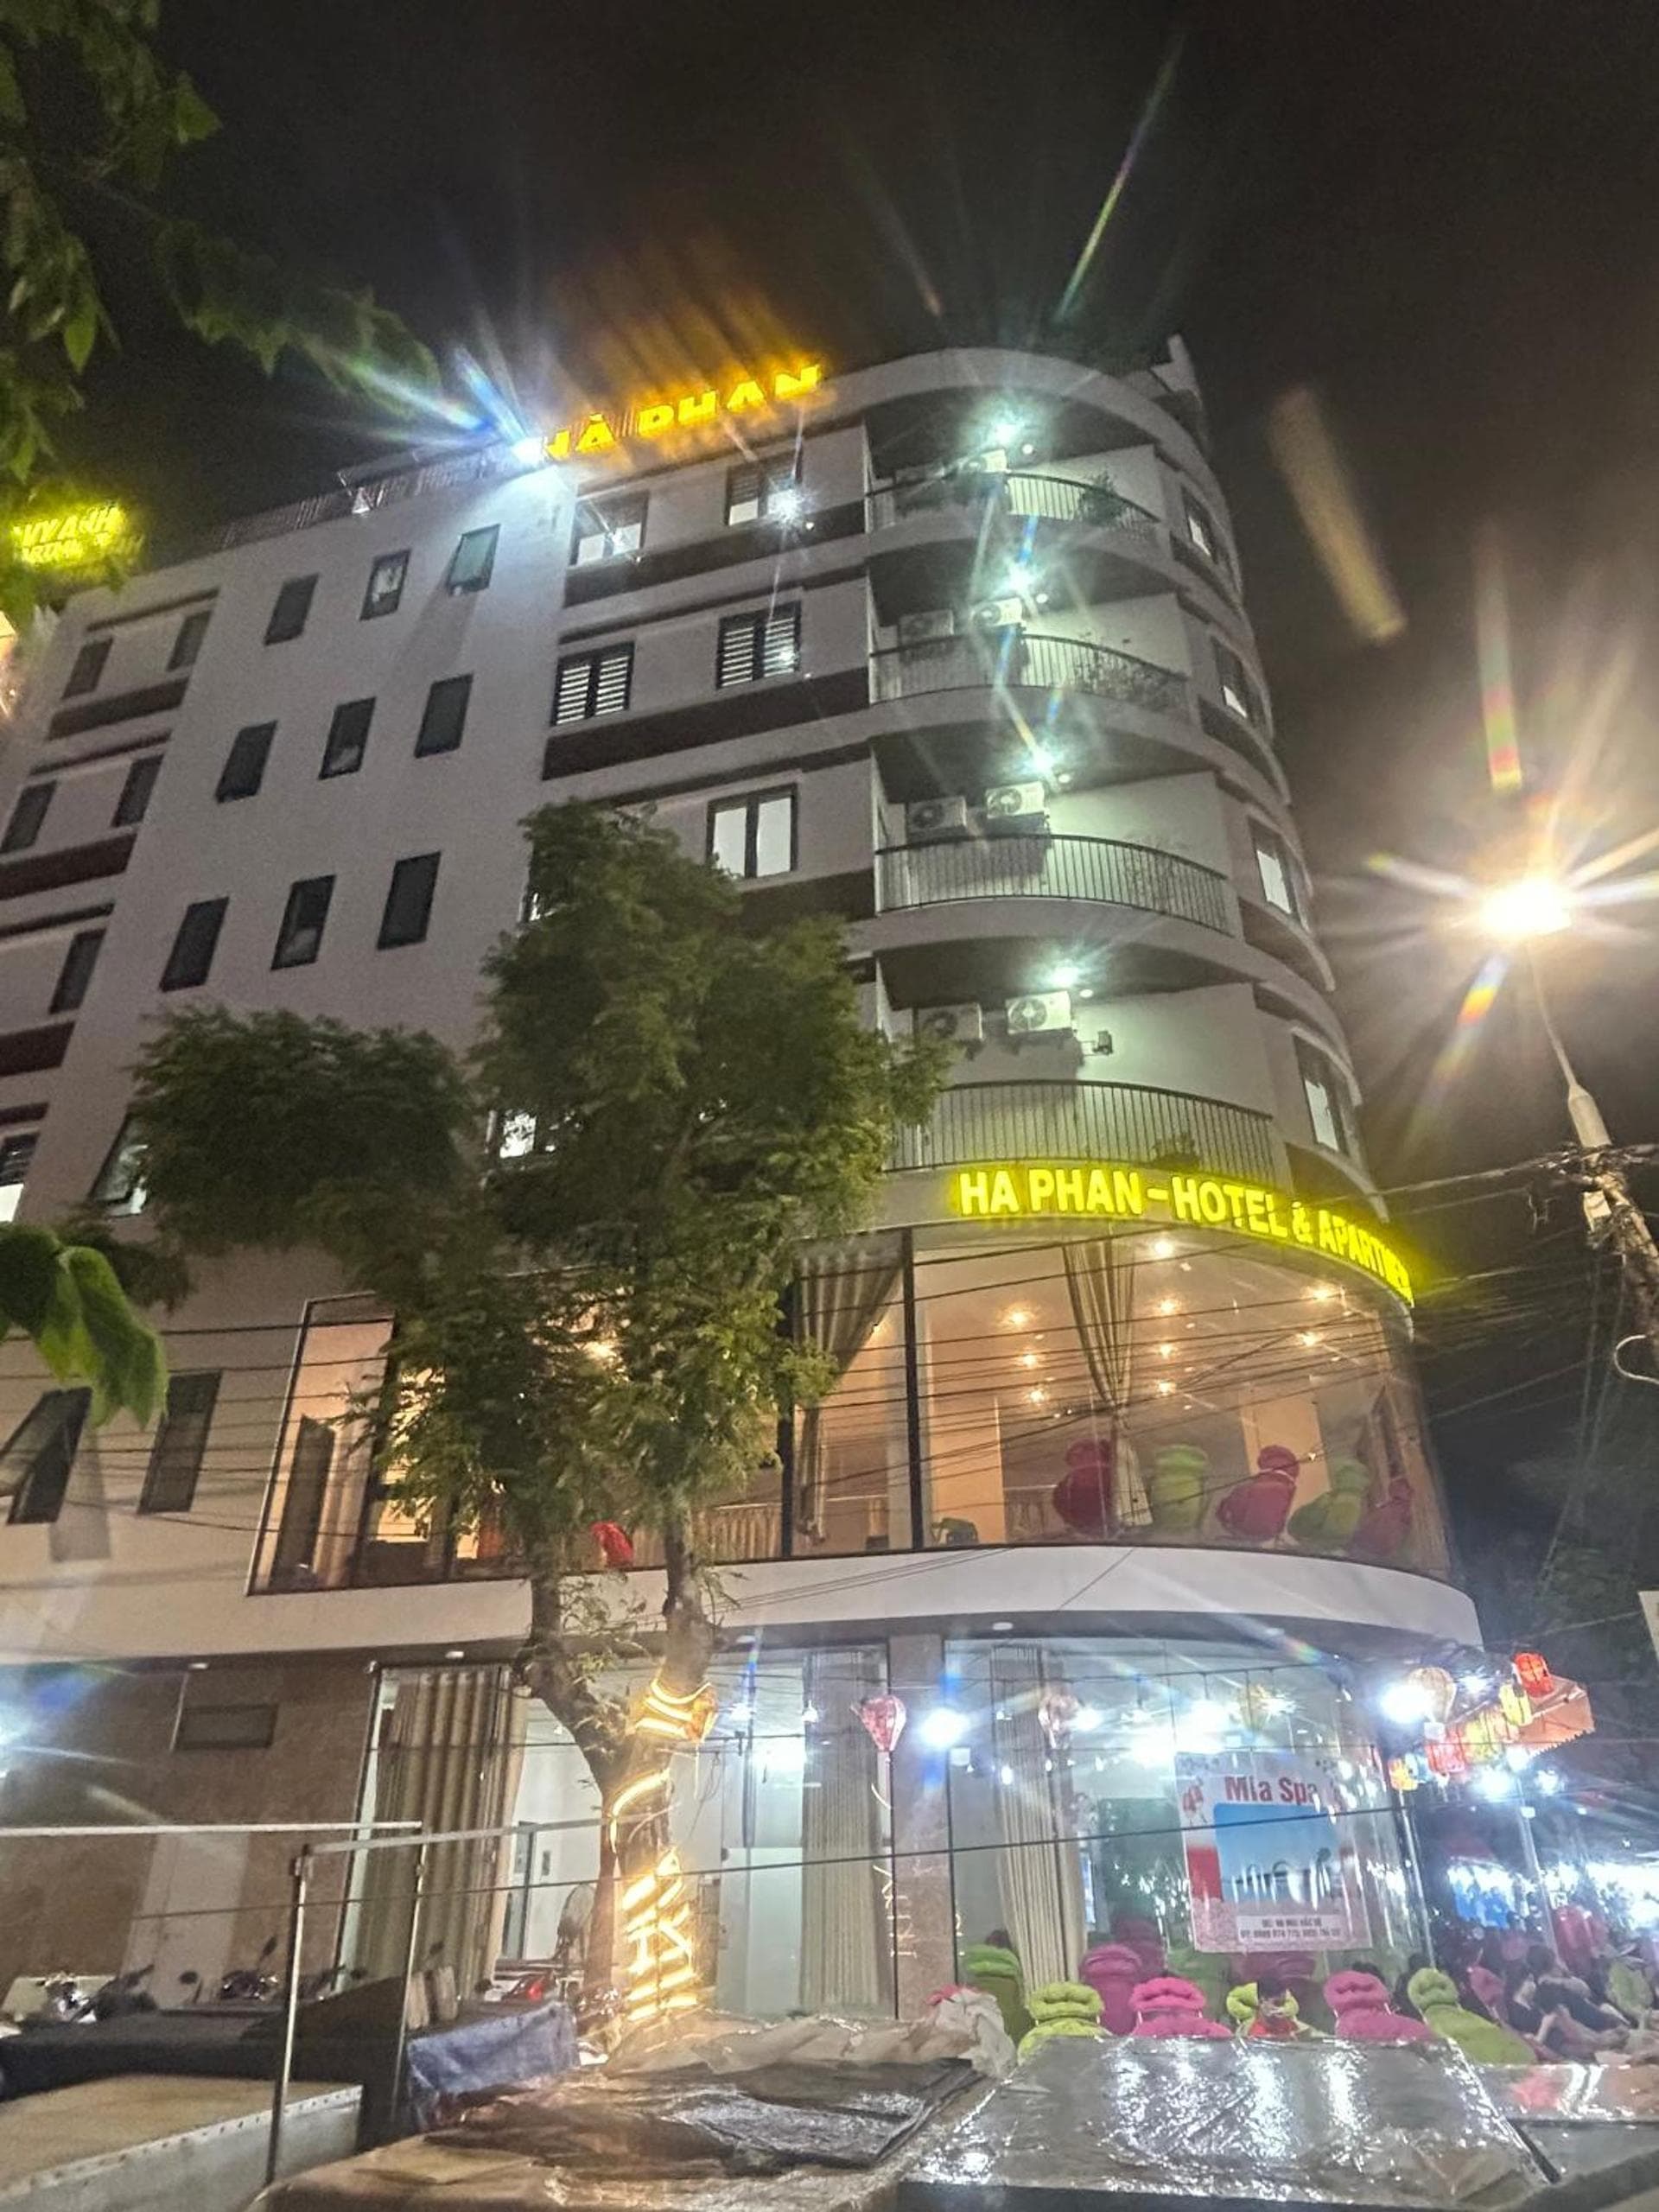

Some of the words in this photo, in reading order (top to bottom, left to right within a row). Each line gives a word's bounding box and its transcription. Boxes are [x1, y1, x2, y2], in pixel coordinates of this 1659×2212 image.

[638, 364, 823, 437] PHAN
[958, 1169, 1020, 1215] HA
[1028, 1168, 1143, 1215] PHAN
[1171, 1176, 1288, 1238] HOTEL
[1292, 1201, 1313, 1244] &
[1224, 1776, 1273, 1802] Mia
[1279, 1777, 1319, 1806] Spa
